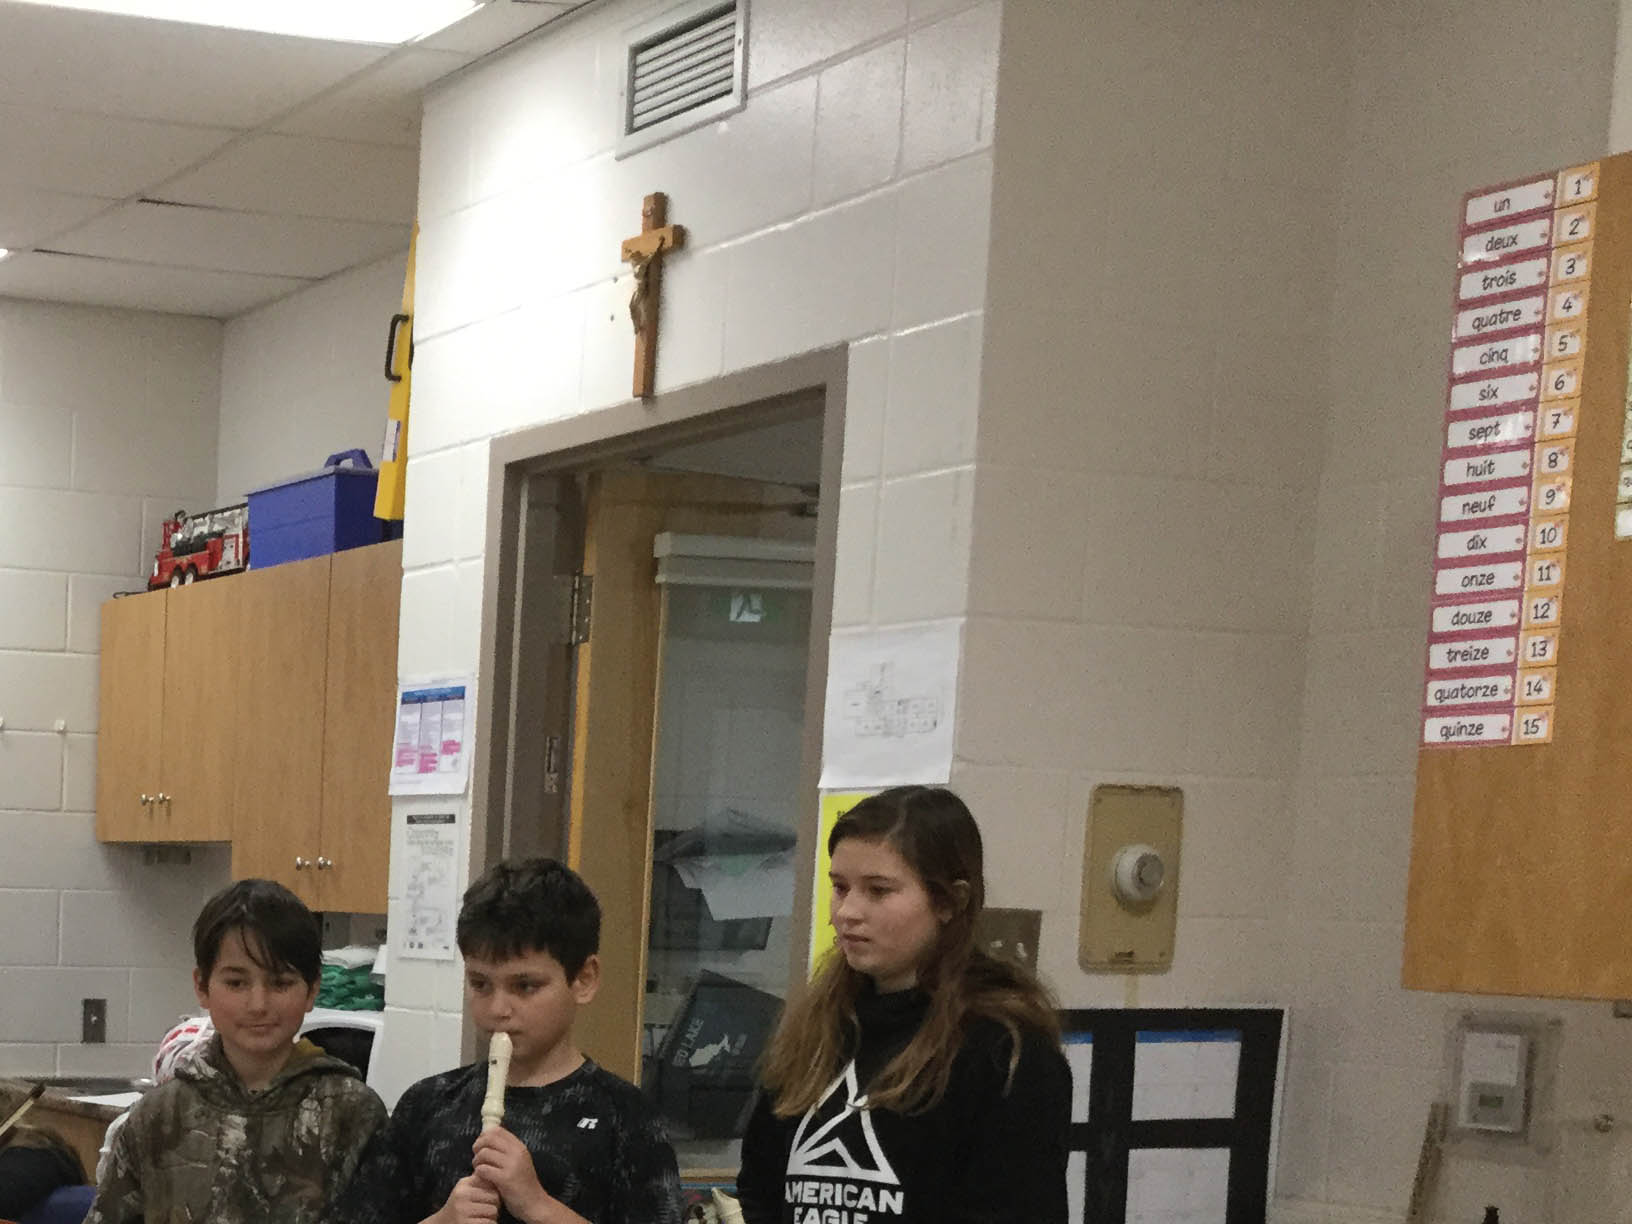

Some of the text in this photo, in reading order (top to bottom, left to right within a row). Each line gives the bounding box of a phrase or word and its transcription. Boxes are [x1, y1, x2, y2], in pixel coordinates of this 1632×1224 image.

[1493, 179, 1582, 212] un 1
[1485, 219, 1579, 252] deux 2
[1481, 259, 1576, 290] trois 3
[1471, 296, 1572, 330] quatre 4
[1479, 335, 1569, 366] cinq 5
[1478, 374, 1565, 400] six 6
[1468, 413, 1561, 441] sept 7
[1466, 452, 1558, 477] huit 8
[1461, 489, 1556, 515] neuf 9
[1466, 527, 1557, 550] dix 10
[1461, 565, 1552, 588] onze 11
[1451, 602, 1550, 627] douze 12
[1446, 641, 1547, 664] treize 13
[1434, 680, 1543, 702] quatorze 14
[1439, 718, 1540, 738] quinze 15
